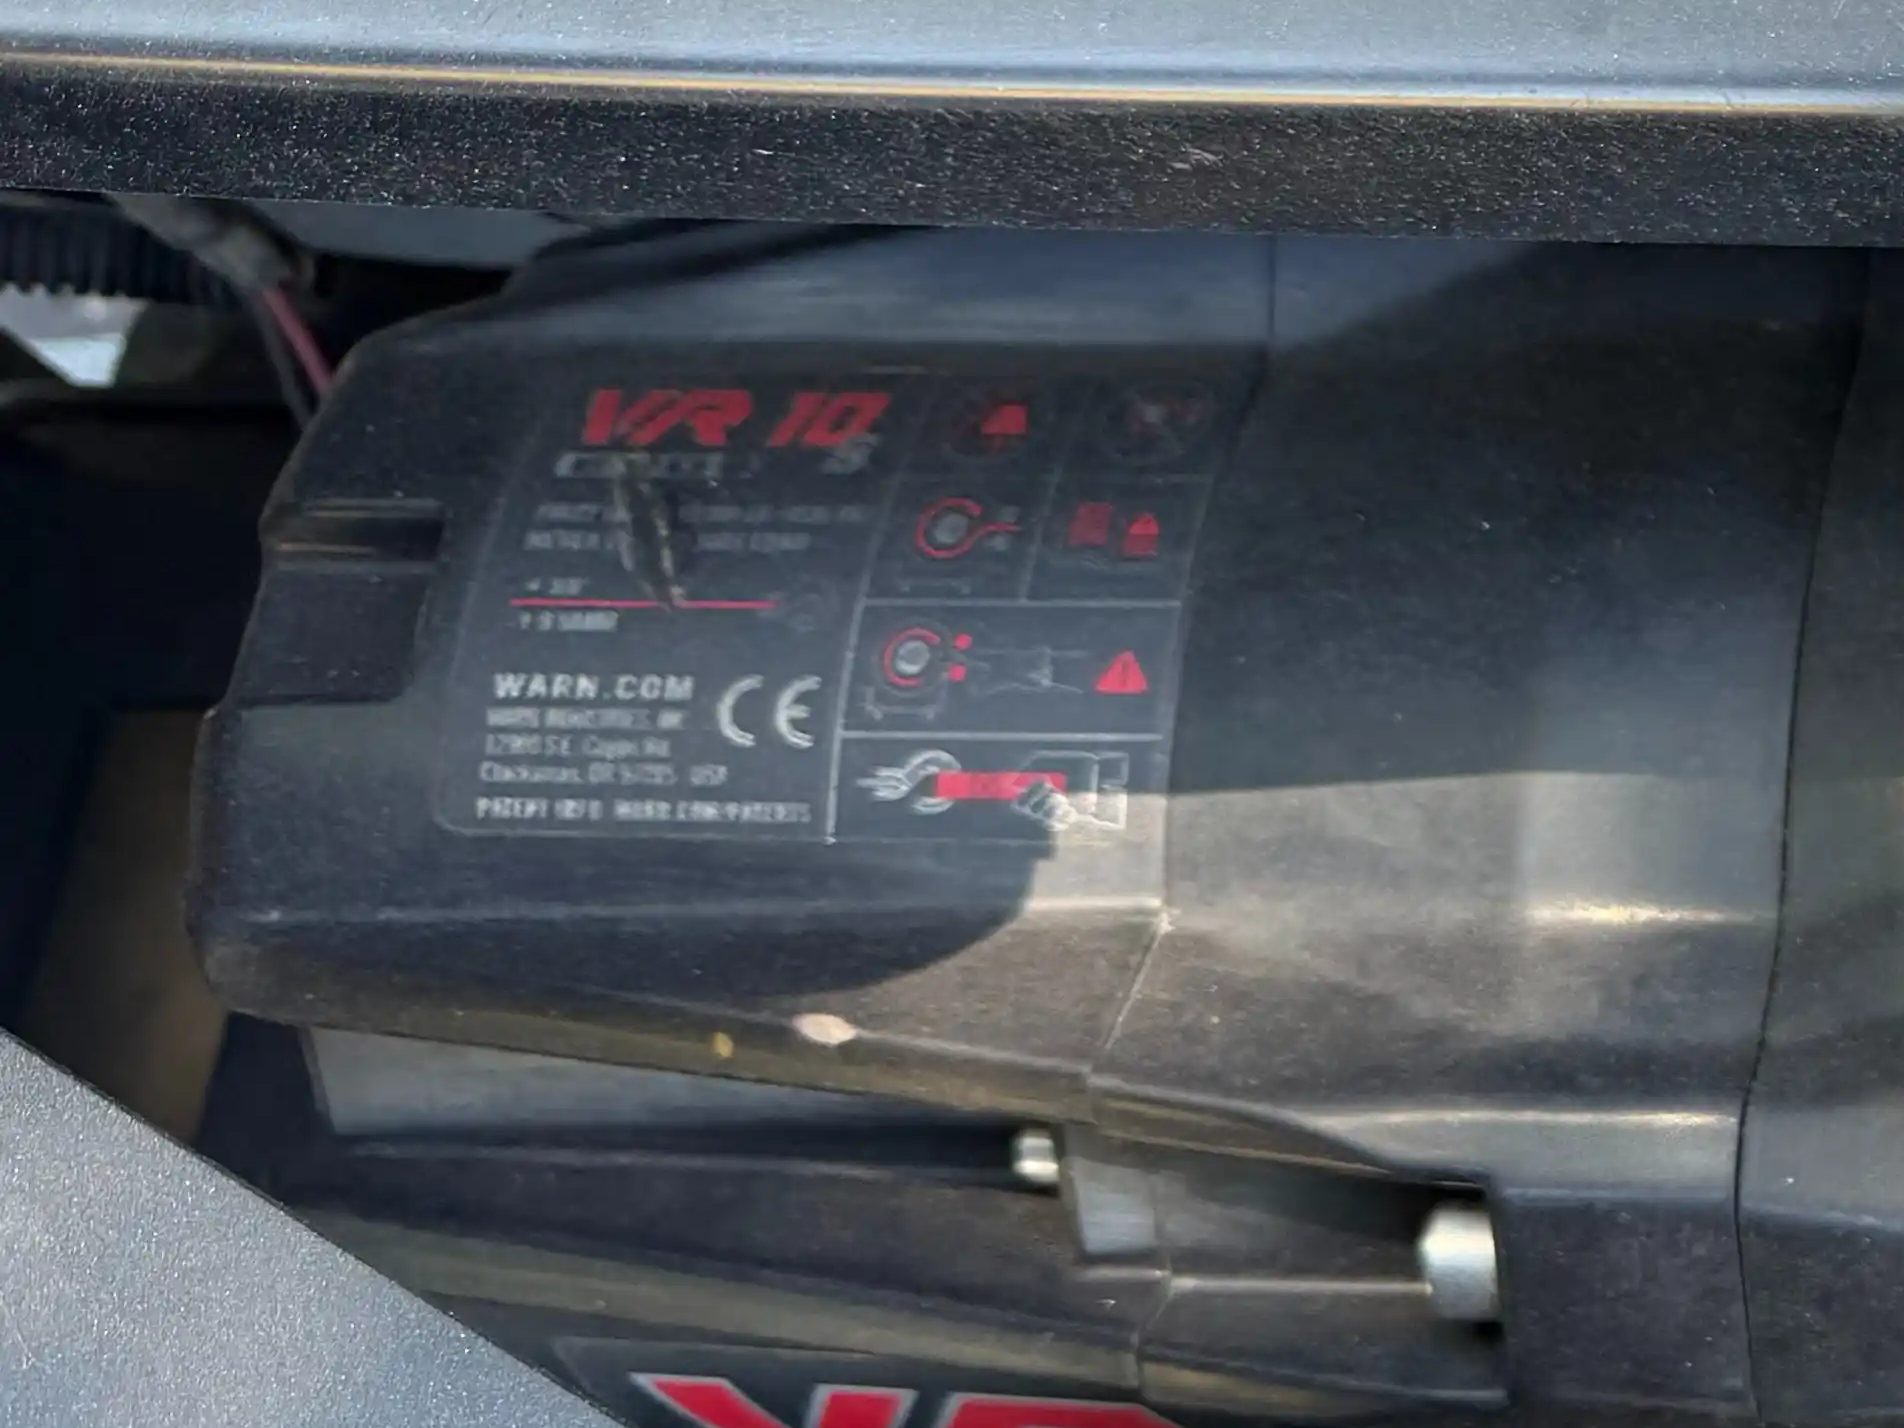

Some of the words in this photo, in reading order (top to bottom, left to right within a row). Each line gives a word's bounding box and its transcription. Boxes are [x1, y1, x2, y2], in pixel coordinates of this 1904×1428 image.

[582, 388, 753, 446] VR
[765, 392, 892, 448] 10
[494, 672, 695, 701] WARN.COM
